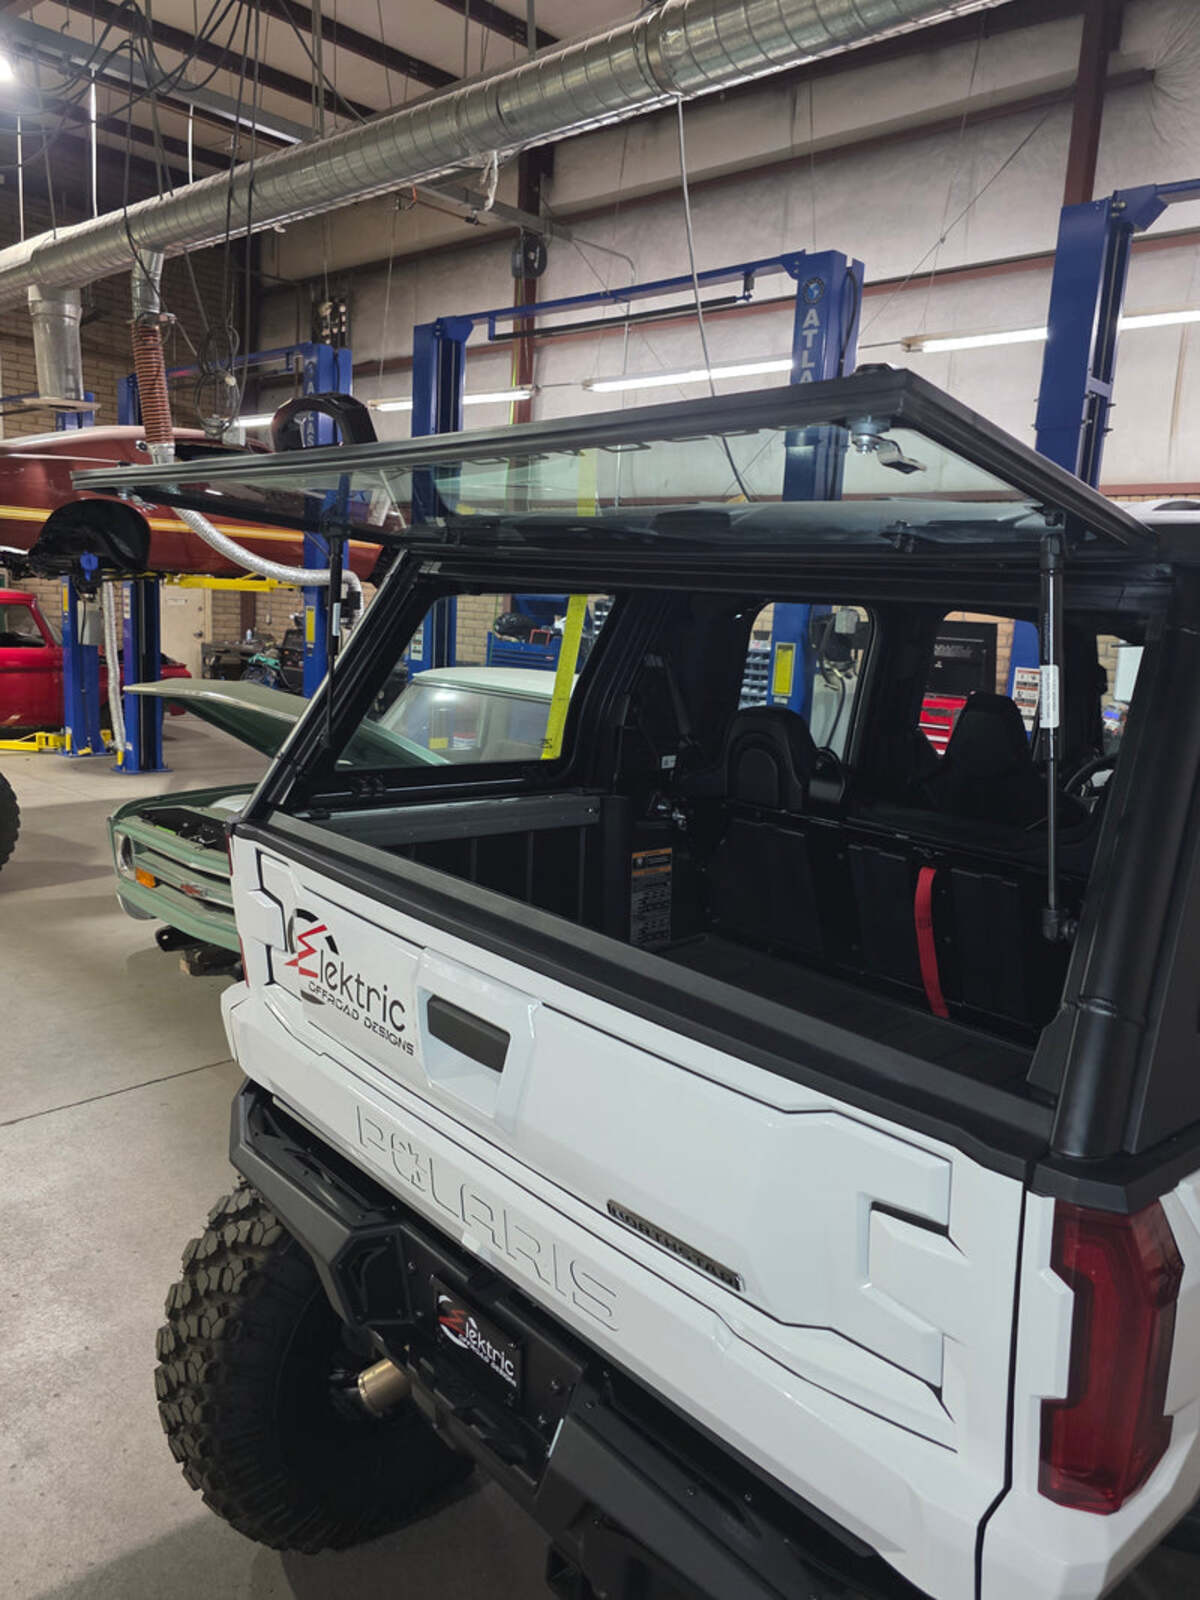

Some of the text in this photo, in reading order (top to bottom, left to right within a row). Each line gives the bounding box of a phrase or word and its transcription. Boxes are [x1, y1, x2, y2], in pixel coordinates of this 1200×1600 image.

[308, 981, 415, 1056] OFFROAD DESIGNS
[356, 1104, 620, 1332] POLARIS
[607, 1201, 741, 1291] NORTHSTAR
